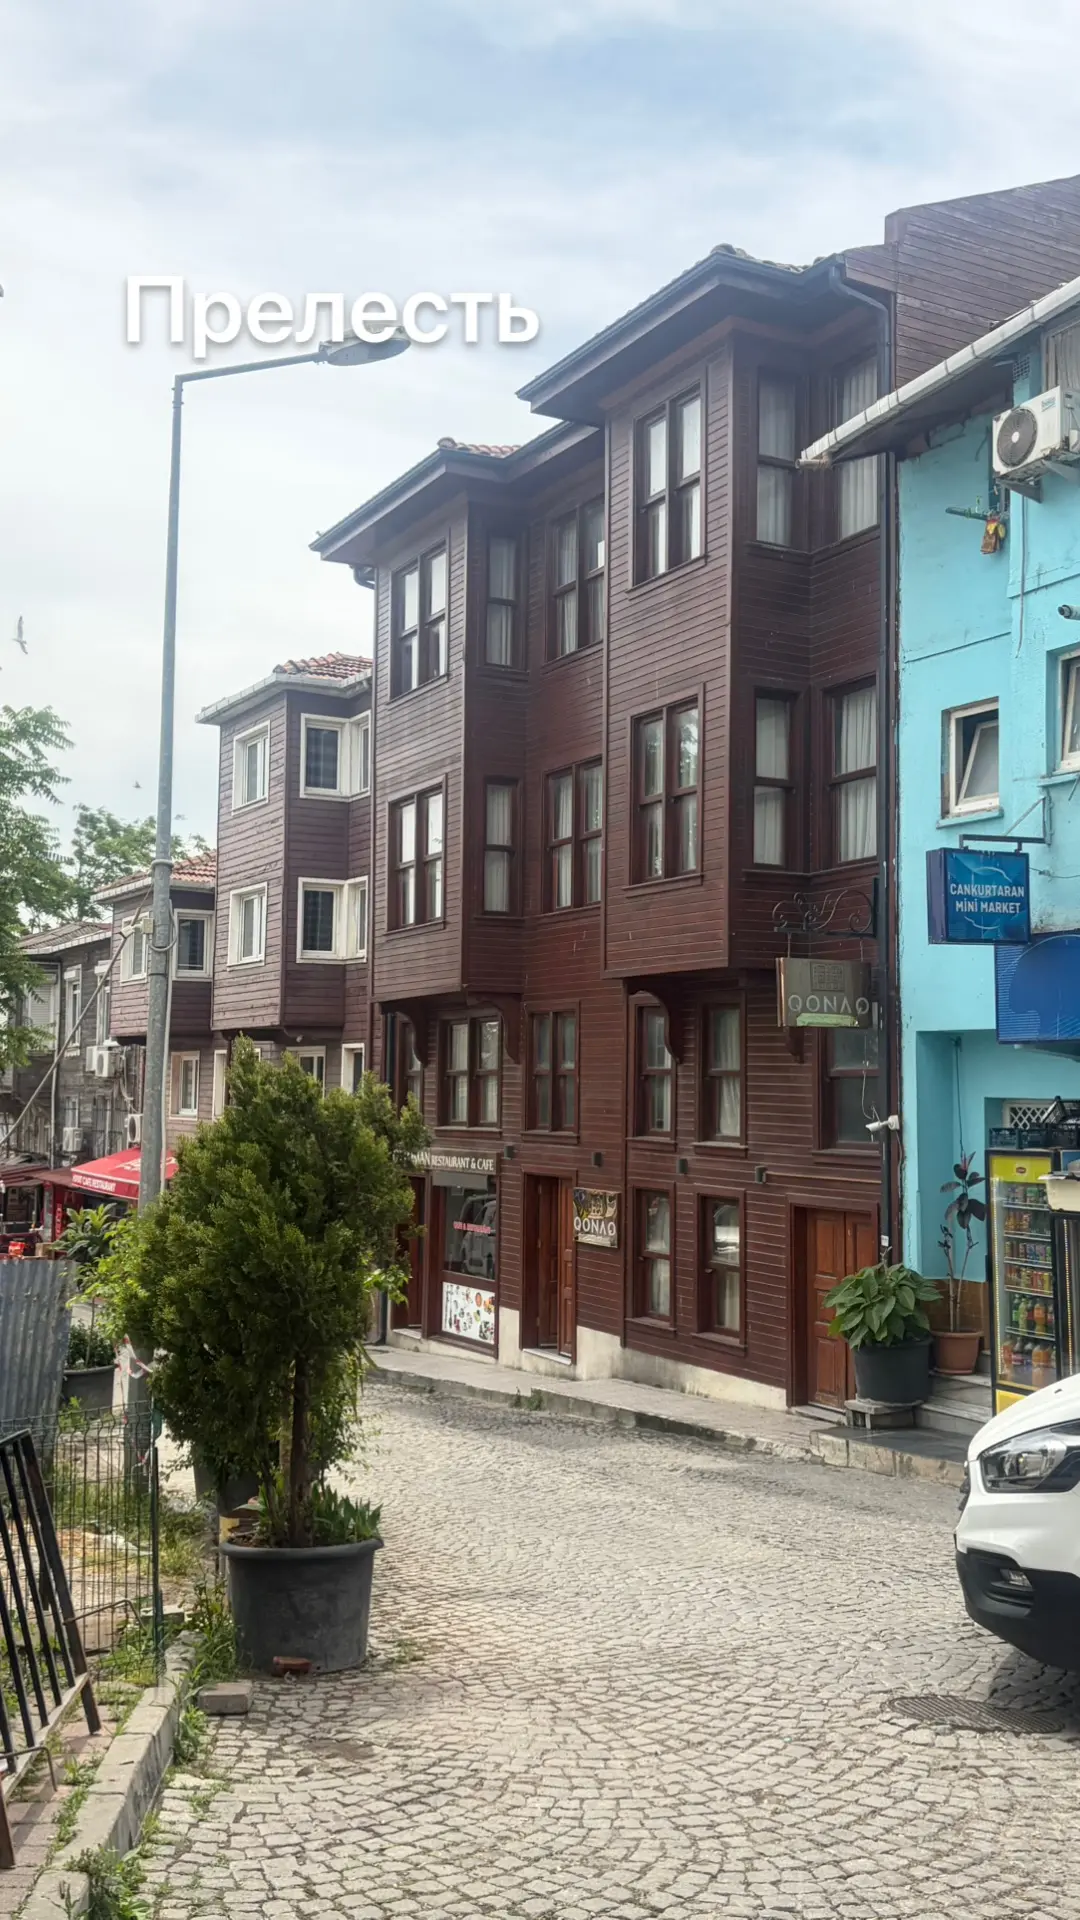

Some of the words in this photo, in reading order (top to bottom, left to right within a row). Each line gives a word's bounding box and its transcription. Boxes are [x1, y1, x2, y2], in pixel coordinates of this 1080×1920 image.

[950, 884, 1025, 897] CANKURTARAN
[981, 901, 1021, 914] MARKET
[788, 994, 870, 1015] QONAQ
[431, 1155, 470, 1169] RESTAURANT
[470, 1158, 476, 1169] &
[477, 1158, 494, 1171] CAFE
[574, 1216, 616, 1236] QONAQ
